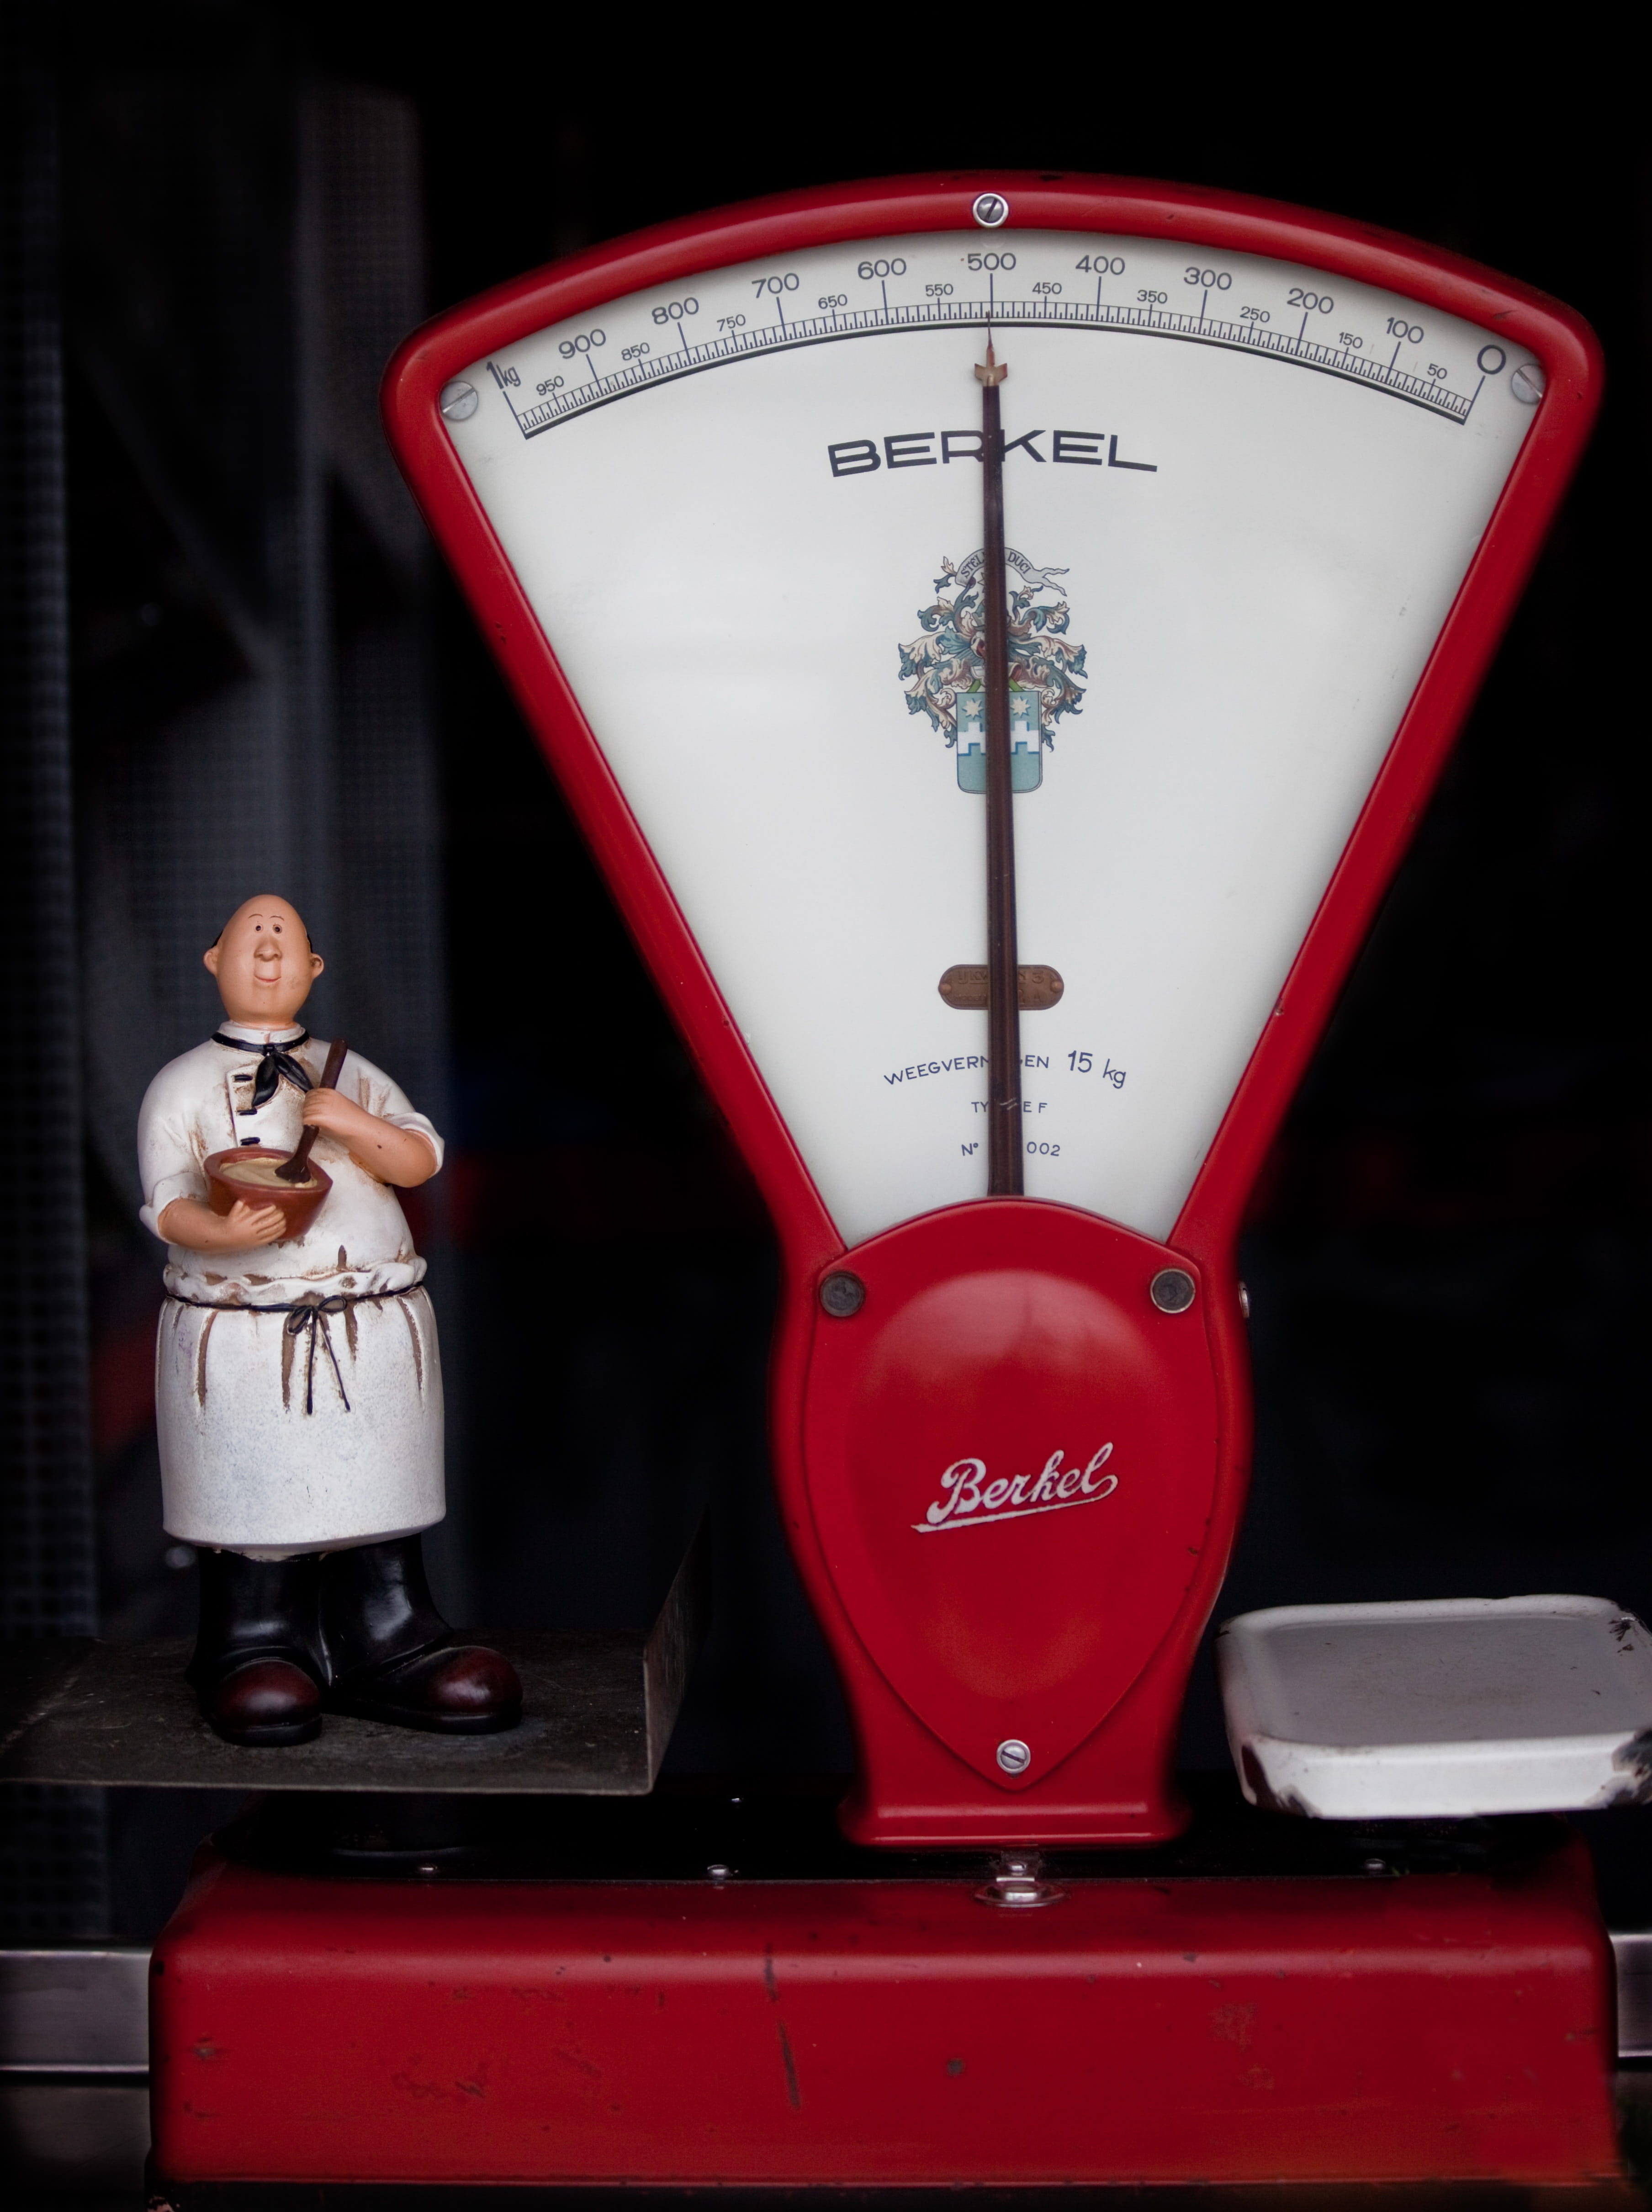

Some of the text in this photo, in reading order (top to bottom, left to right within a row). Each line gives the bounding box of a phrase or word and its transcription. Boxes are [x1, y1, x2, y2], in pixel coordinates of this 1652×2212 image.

[536, 282, 1448, 396] 950 850 750 650 550 450 350 250 150 50
[558, 329, 606, 359] 900
[651, 297, 699, 325] 800
[751, 273, 800, 298] 700
[858, 258, 907, 280] 600
[967, 253, 1017, 271] 500
[1075, 255, 1125, 275] 400
[1183, 267, 1233, 290] 300
[1287, 288, 1334, 314] 200
[1386, 317, 1424, 344] 100
[1477, 345, 1506, 375] 0
[827, 429, 1158, 477] BERKEL
[1068, 1050, 1093, 1073] 15
[1102, 1058, 1127, 1089] kg
[911, 1442, 1118, 1533] Berkel
